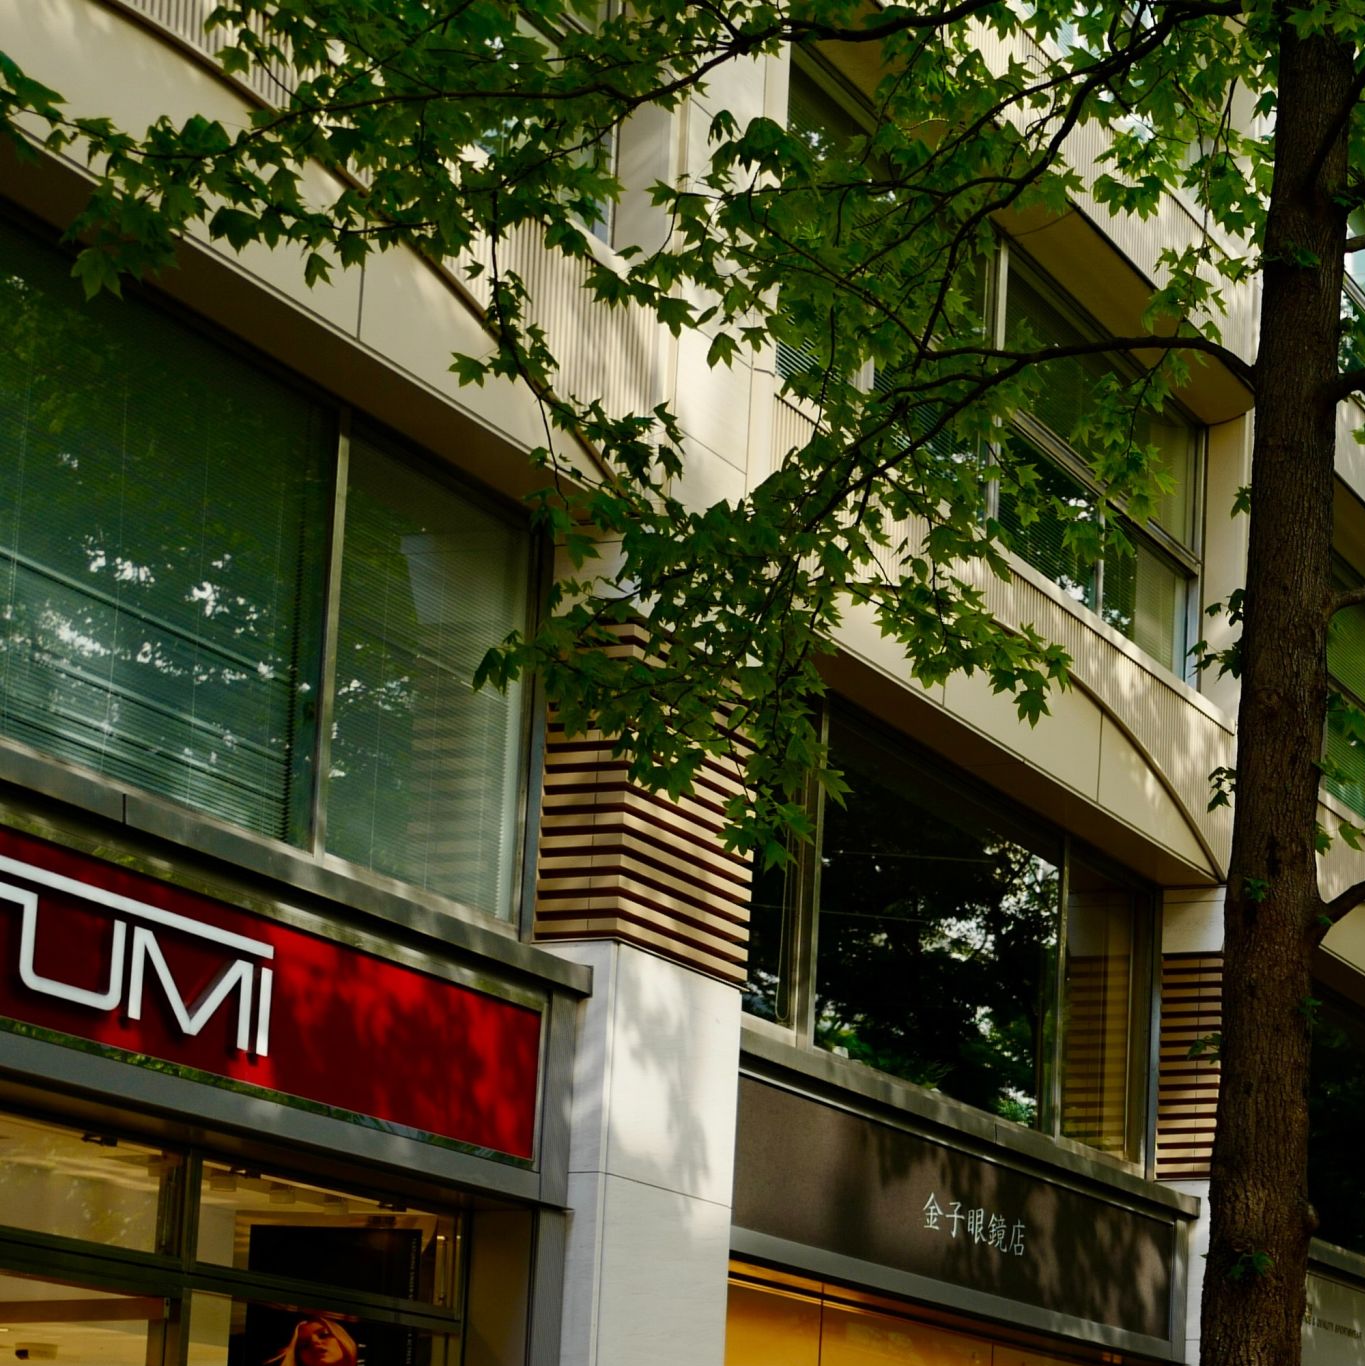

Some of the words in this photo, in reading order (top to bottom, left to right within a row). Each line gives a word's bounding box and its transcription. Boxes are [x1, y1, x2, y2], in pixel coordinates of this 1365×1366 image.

[923, 1191, 1026, 1256] 金子眼鏡店
